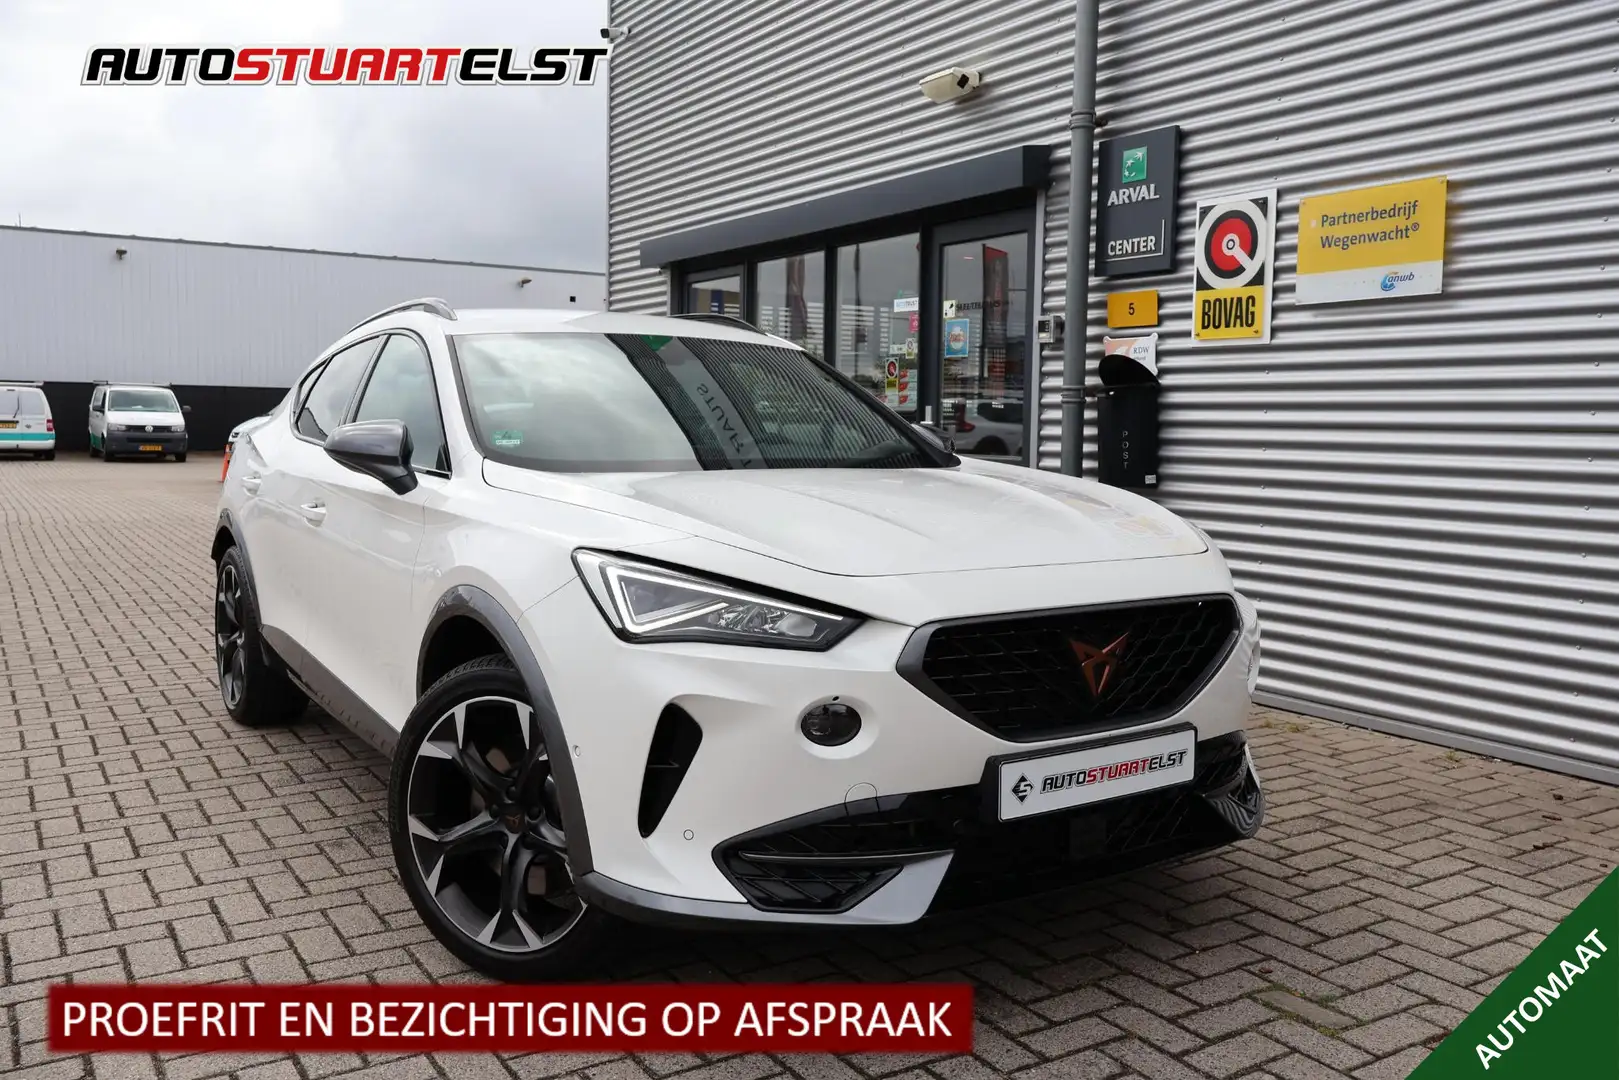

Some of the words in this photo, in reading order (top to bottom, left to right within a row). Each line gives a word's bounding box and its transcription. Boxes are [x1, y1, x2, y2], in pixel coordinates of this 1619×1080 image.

[1107, 183, 1160, 206] ARVAL
[1321, 200, 1419, 228] Partnerbedrijf
[1107, 235, 1156, 256] CENTER
[1387, 271, 1415, 283] anwb
[1128, 302, 1136, 316] 5
[1201, 295, 1256, 330] BOVAG
[1133, 346, 1150, 355] RDW
[1040, 749, 1188, 794] AUTOSTUARTELST
